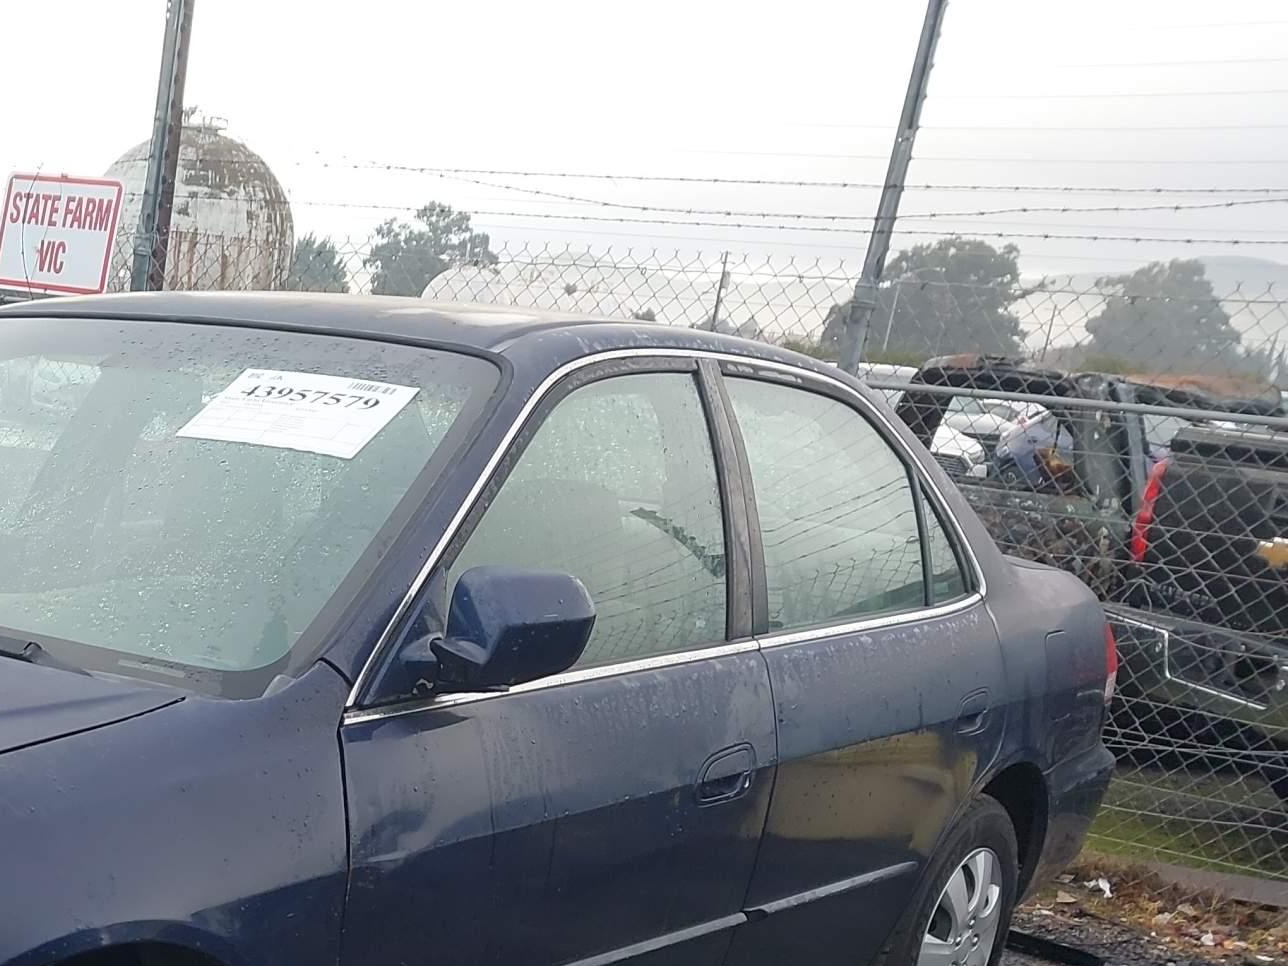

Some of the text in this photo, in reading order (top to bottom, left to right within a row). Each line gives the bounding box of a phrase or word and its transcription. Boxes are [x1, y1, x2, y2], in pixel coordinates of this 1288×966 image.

[9, 191, 114, 232] STATE FARM
[38, 239, 67, 274] VIC
[240, 384, 381, 411] 43957579
